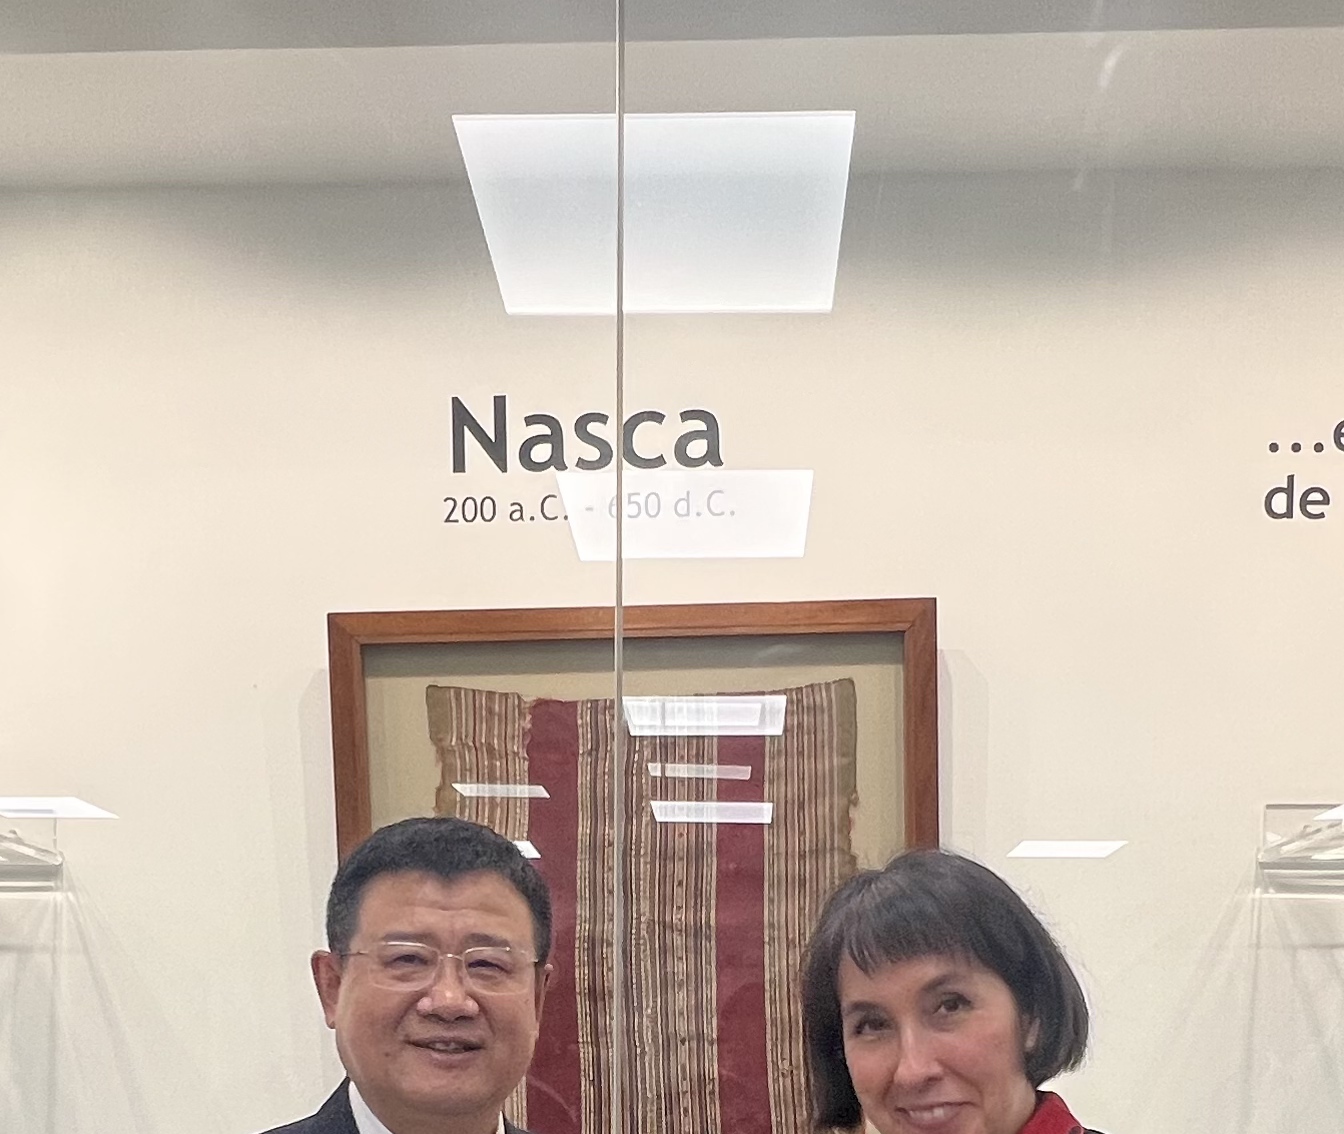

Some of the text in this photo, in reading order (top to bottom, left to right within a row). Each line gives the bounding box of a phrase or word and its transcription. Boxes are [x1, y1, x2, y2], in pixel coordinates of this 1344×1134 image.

[451, 394, 724, 474] Nasca
[443, 495, 497, 524] 200
[508, 493, 569, 523] a.C.
[608, 491, 662, 519] 650
[673, 489, 737, 518] d.C.
[1263, 473, 1331, 520] de
